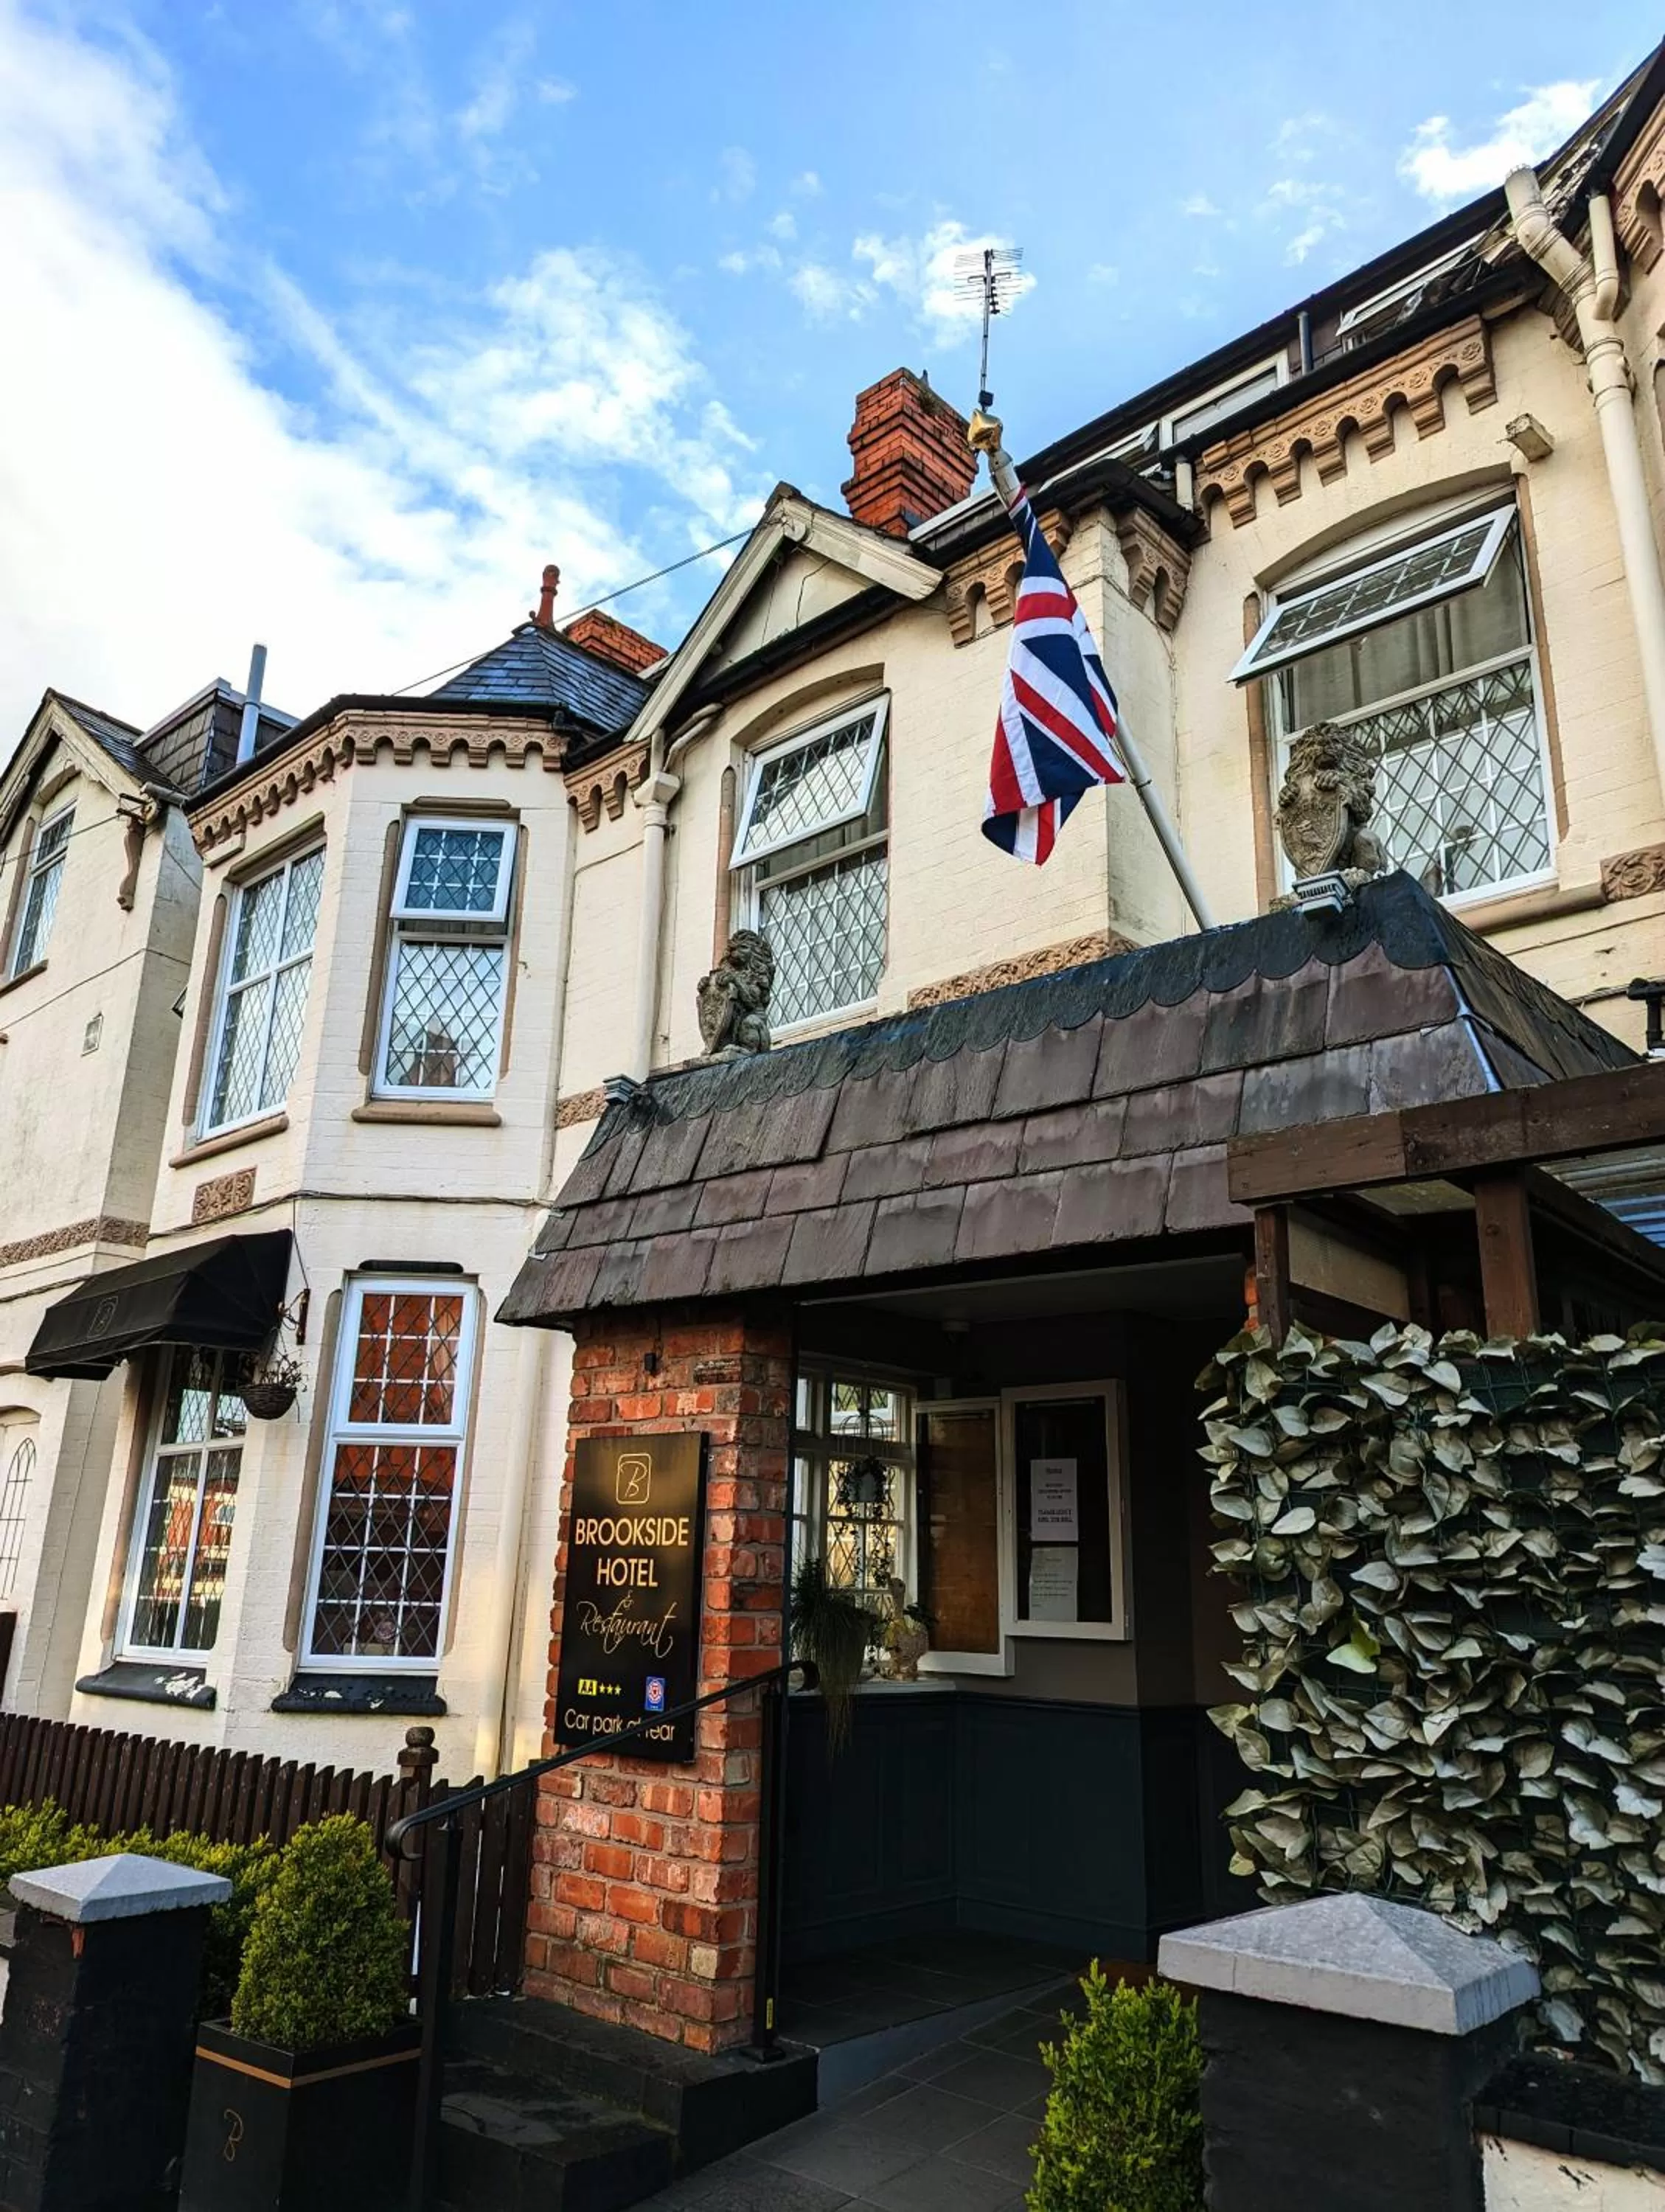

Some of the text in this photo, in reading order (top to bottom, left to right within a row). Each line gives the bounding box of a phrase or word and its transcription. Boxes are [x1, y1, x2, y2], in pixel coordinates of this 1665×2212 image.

[620, 1461, 648, 1498] B
[574, 1517, 689, 1546] BROOKSIDE
[597, 1557, 658, 1587] HOTEL
[576, 1599, 678, 1658] Restaurant
[564, 1708, 589, 1731] Car
[592, 1714, 623, 1735] park
